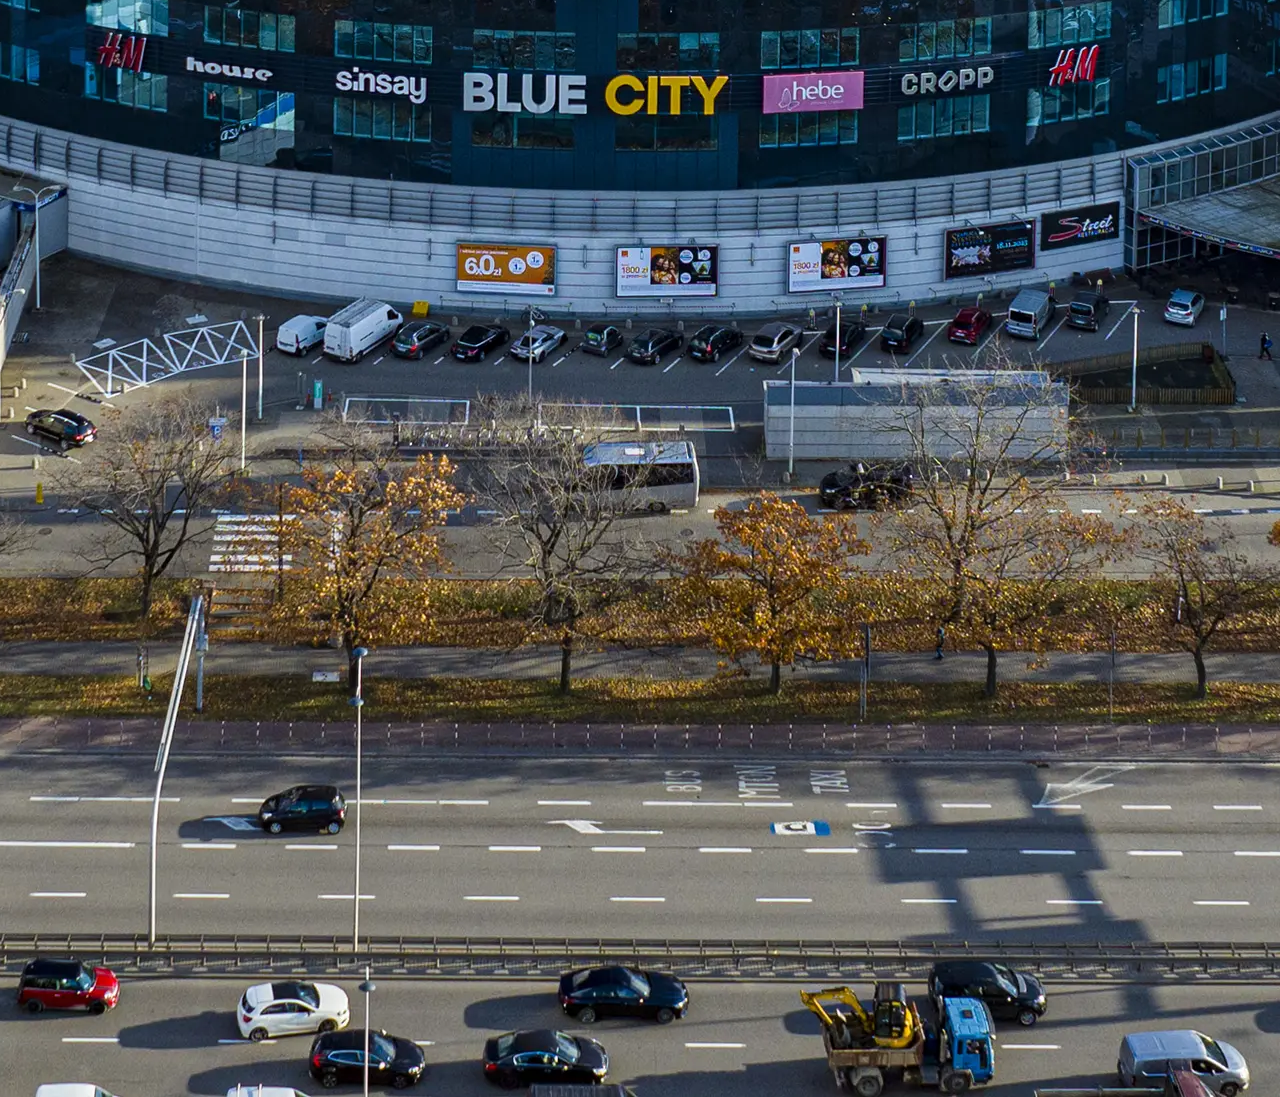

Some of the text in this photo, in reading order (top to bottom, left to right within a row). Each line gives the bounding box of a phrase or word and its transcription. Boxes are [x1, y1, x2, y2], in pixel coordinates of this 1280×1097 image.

[96, 32, 147, 73] H&M
[186, 56, 274, 83] house
[1048, 44, 1100, 87] H&M
[335, 66, 427, 104] sinsay
[462, 71, 730, 116] BLUE CITY
[792, 80, 845, 101] hebe
[900, 66, 995, 96] CROPP
[663, 770, 703, 793] BUS
[810, 769, 850, 795] TAXI
